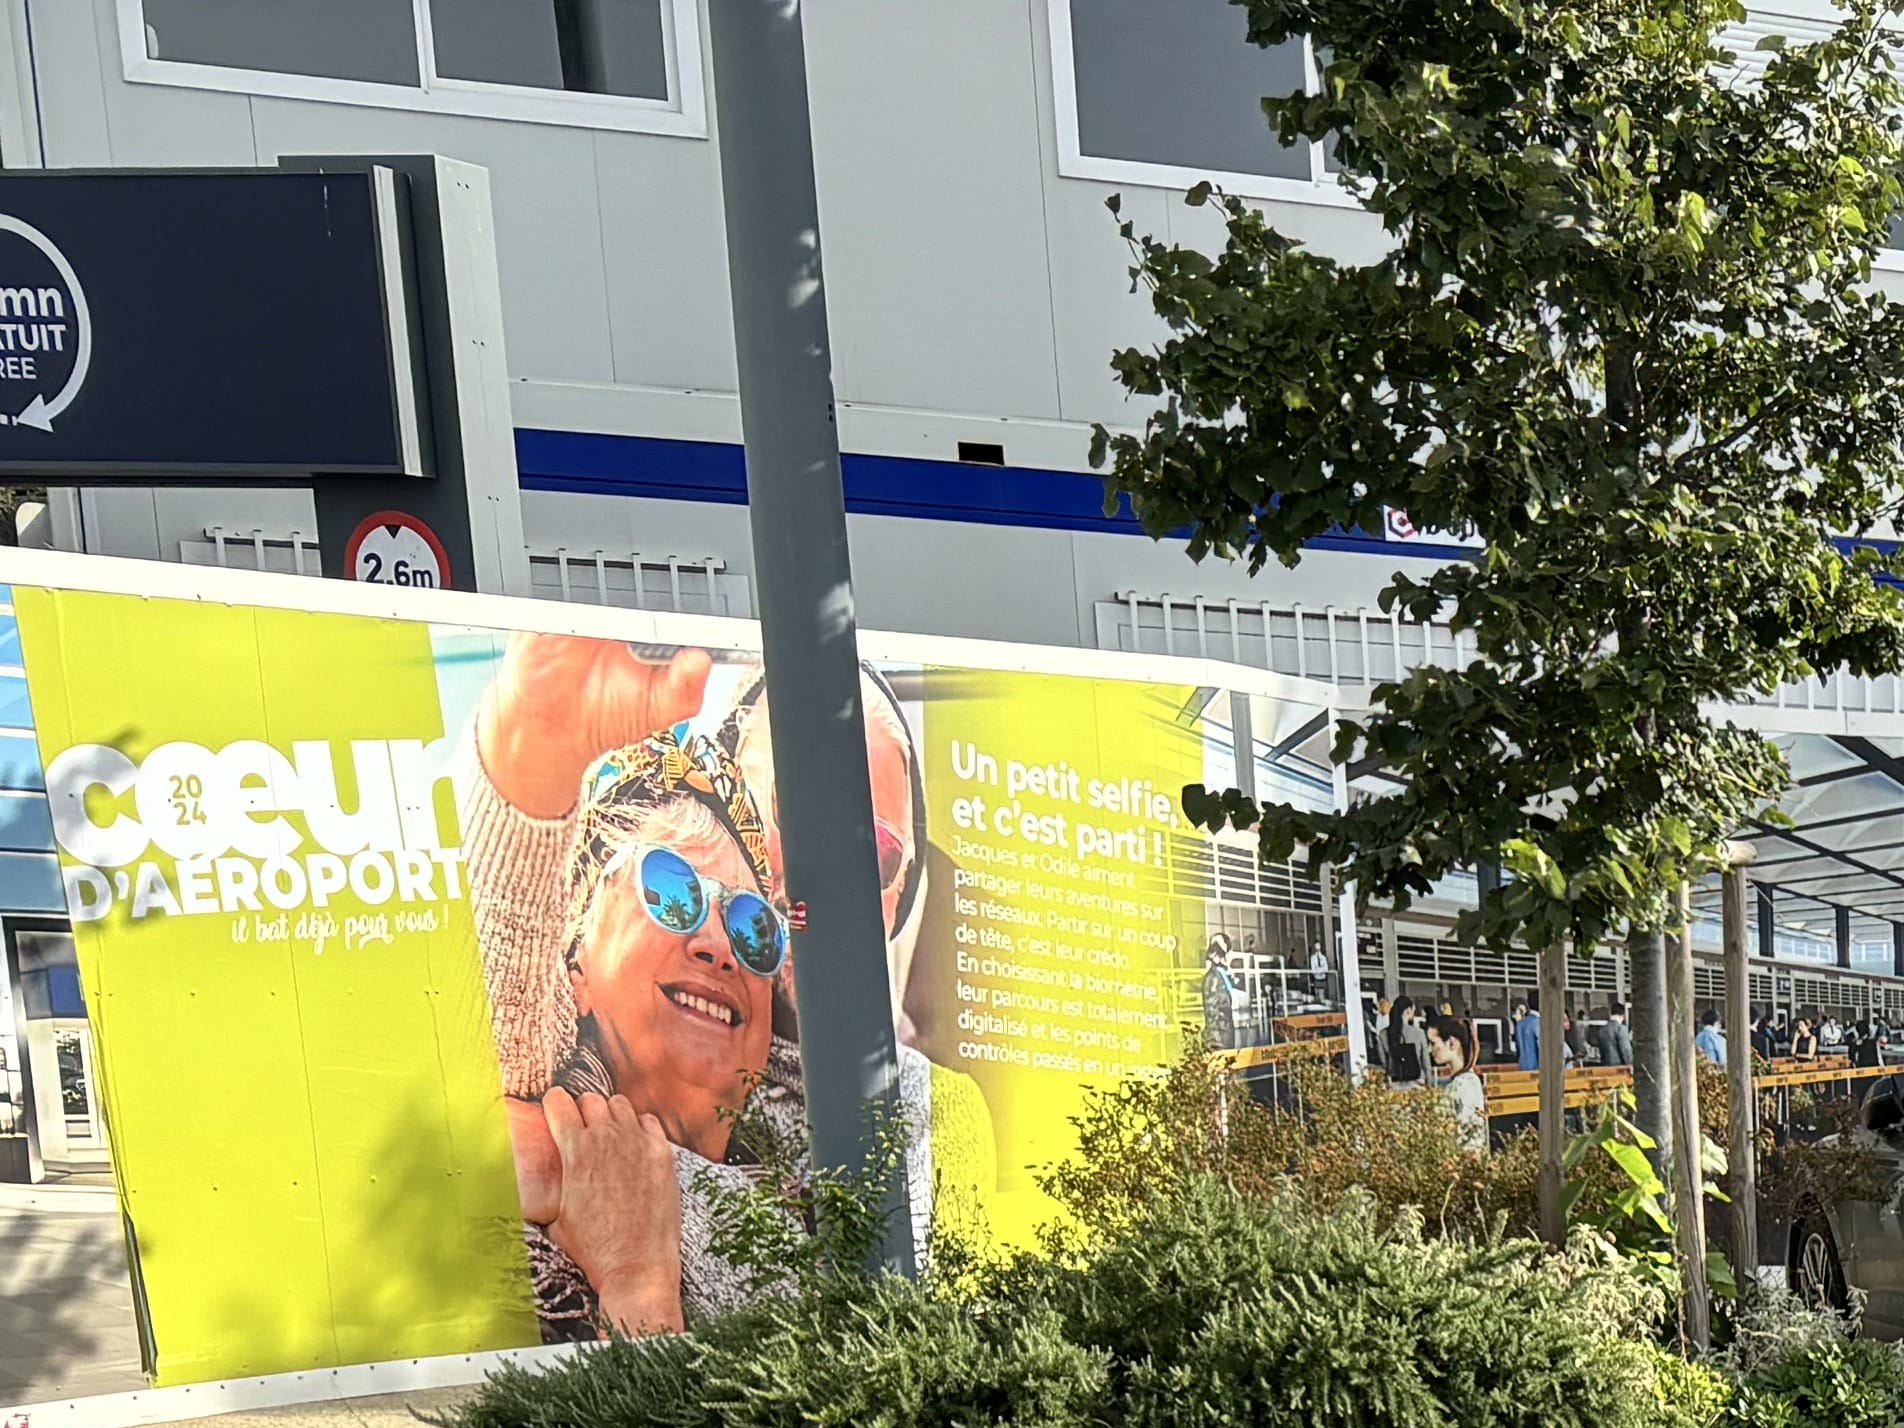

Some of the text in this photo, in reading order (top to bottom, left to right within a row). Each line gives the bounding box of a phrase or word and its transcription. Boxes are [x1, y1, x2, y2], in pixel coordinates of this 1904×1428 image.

[363, 552, 434, 588] 2.6m
[169, 773, 203, 800] 20
[951, 739, 1181, 830] Un petit selfie,
[174, 802, 208, 826] 24
[952, 796, 1163, 866] et c'est parti !
[63, 846, 468, 923] D'AÉROPORT
[953, 835, 1136, 889] Jacques et Odile aiment
[954, 868, 1164, 921] partager leurs aventures sur
[231, 919, 249, 944] il
[255, 915, 290, 941] bat
[295, 911, 340, 956] déjà
[344, 917, 394, 950] pour
[394, 911, 438, 935] vous
[955, 895, 1177, 953] les réseaux. Partir sur un coup
[955, 922, 977, 945] de
[980, 927, 1015, 954] tête,
[1055, 939, 1085, 963] leur
[957, 951, 978, 973] En
[981, 956, 1066, 988] choisissant
[1069, 968, 1083, 990] la
[957, 979, 988, 1004] leur
[991, 990, 1060, 1016] parcours
[1061, 998, 1084, 1017] est
[957, 1009, 1142, 1054] digitalisé et les points de
[958, 1039, 1030, 1067] contrôles
[1032, 1048, 1081, 1074] passés
[1083, 1055, 1104, 1074] en
